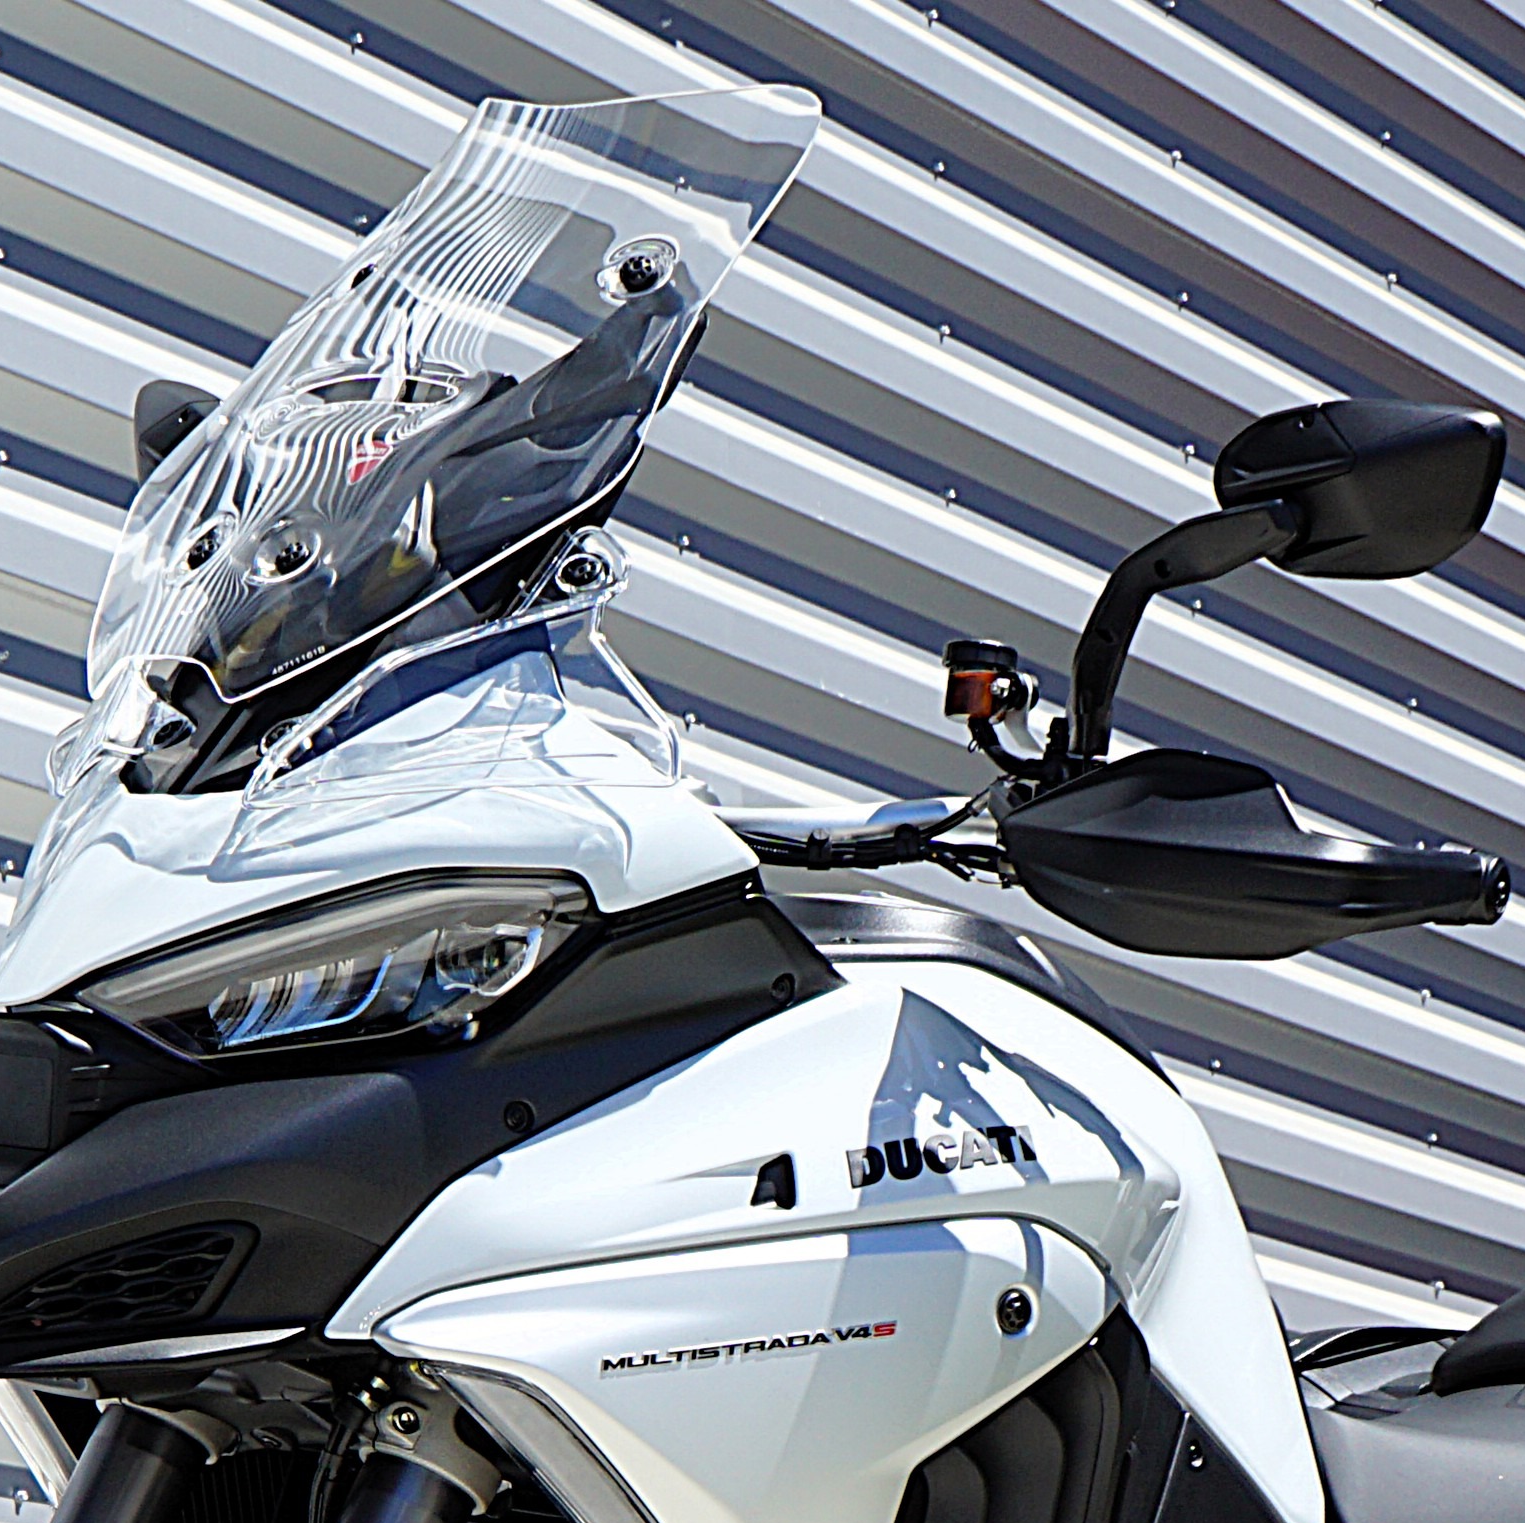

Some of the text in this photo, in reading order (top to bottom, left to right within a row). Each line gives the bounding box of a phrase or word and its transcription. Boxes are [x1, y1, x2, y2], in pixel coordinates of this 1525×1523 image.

[846, 1125, 1037, 1189] DUCATI
[603, 1320, 897, 1371] MULTISTRADA V4S
